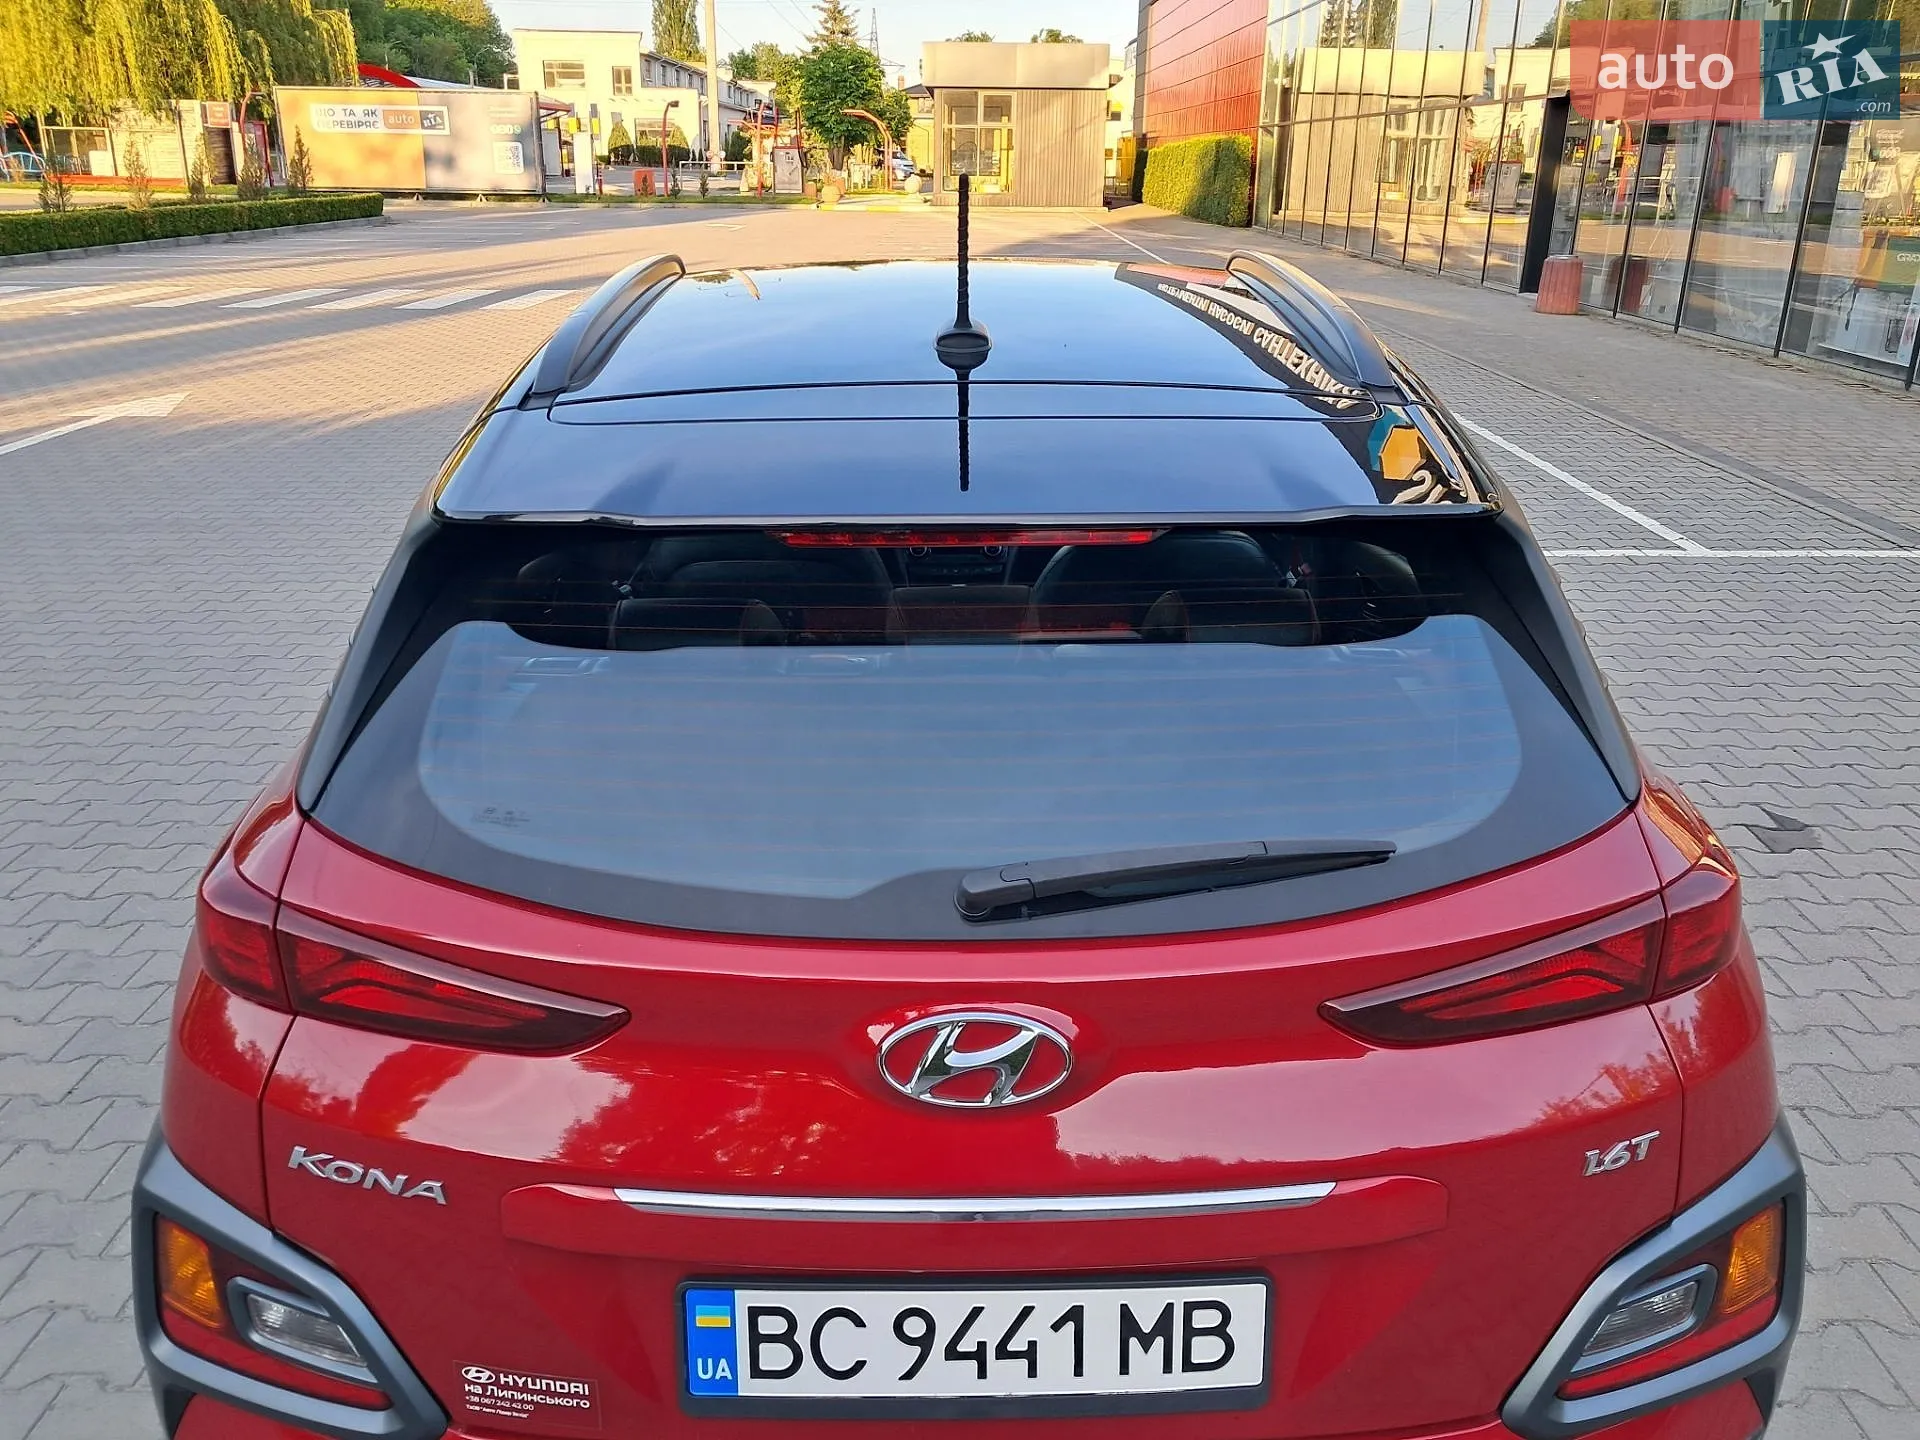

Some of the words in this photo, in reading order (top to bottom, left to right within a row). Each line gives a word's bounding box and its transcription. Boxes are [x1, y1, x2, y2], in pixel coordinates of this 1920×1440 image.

[341, 107, 357, 118] ТА
[362, 108, 378, 118] ЯК
[388, 112, 416, 124] auto
[288, 1145, 447, 1205] KONA
[747, 1305, 867, 1380] BC
[892, 1304, 1086, 1381] 9441
[1119, 1299, 1235, 1376] MB
[697, 1358, 733, 1380] UA
[500, 1373, 590, 1396] HYUNDAI
[464, 1383, 483, 1395] на
[486, 1385, 590, 1409] Липинського
[480, 1396, 496, 1406] 067
[511, 1401, 522, 1410] 42
[523, 1403, 535, 1411] 00
